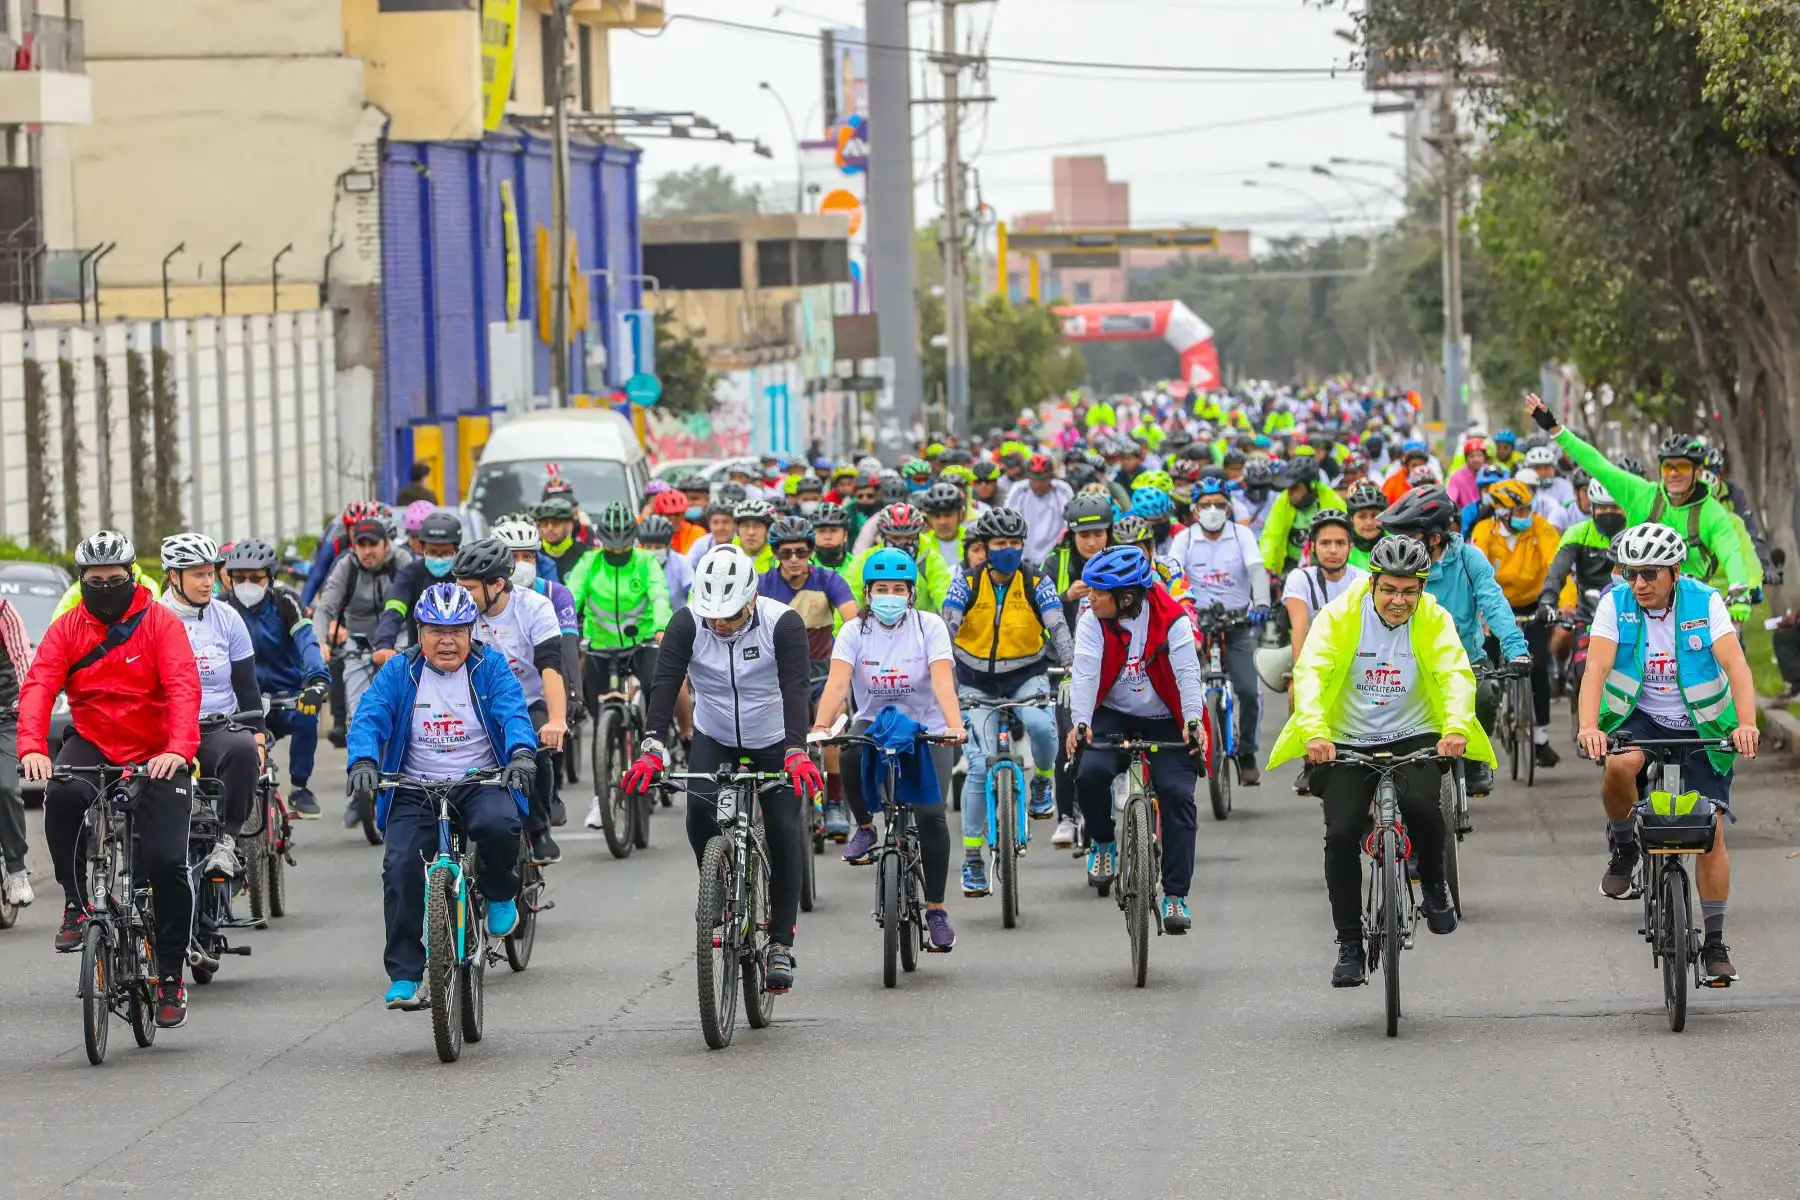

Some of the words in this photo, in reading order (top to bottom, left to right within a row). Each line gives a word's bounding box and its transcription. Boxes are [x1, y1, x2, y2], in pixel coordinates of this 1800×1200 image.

[559, 619, 577, 627] LIMA
[871, 675, 910, 689] MTC
[1365, 669, 1401, 686] MTC
[1356, 683, 1407, 694] BICICLETEADA
[423, 720, 465, 737] MTC
[418, 735, 472, 744] BICICLETEADA
